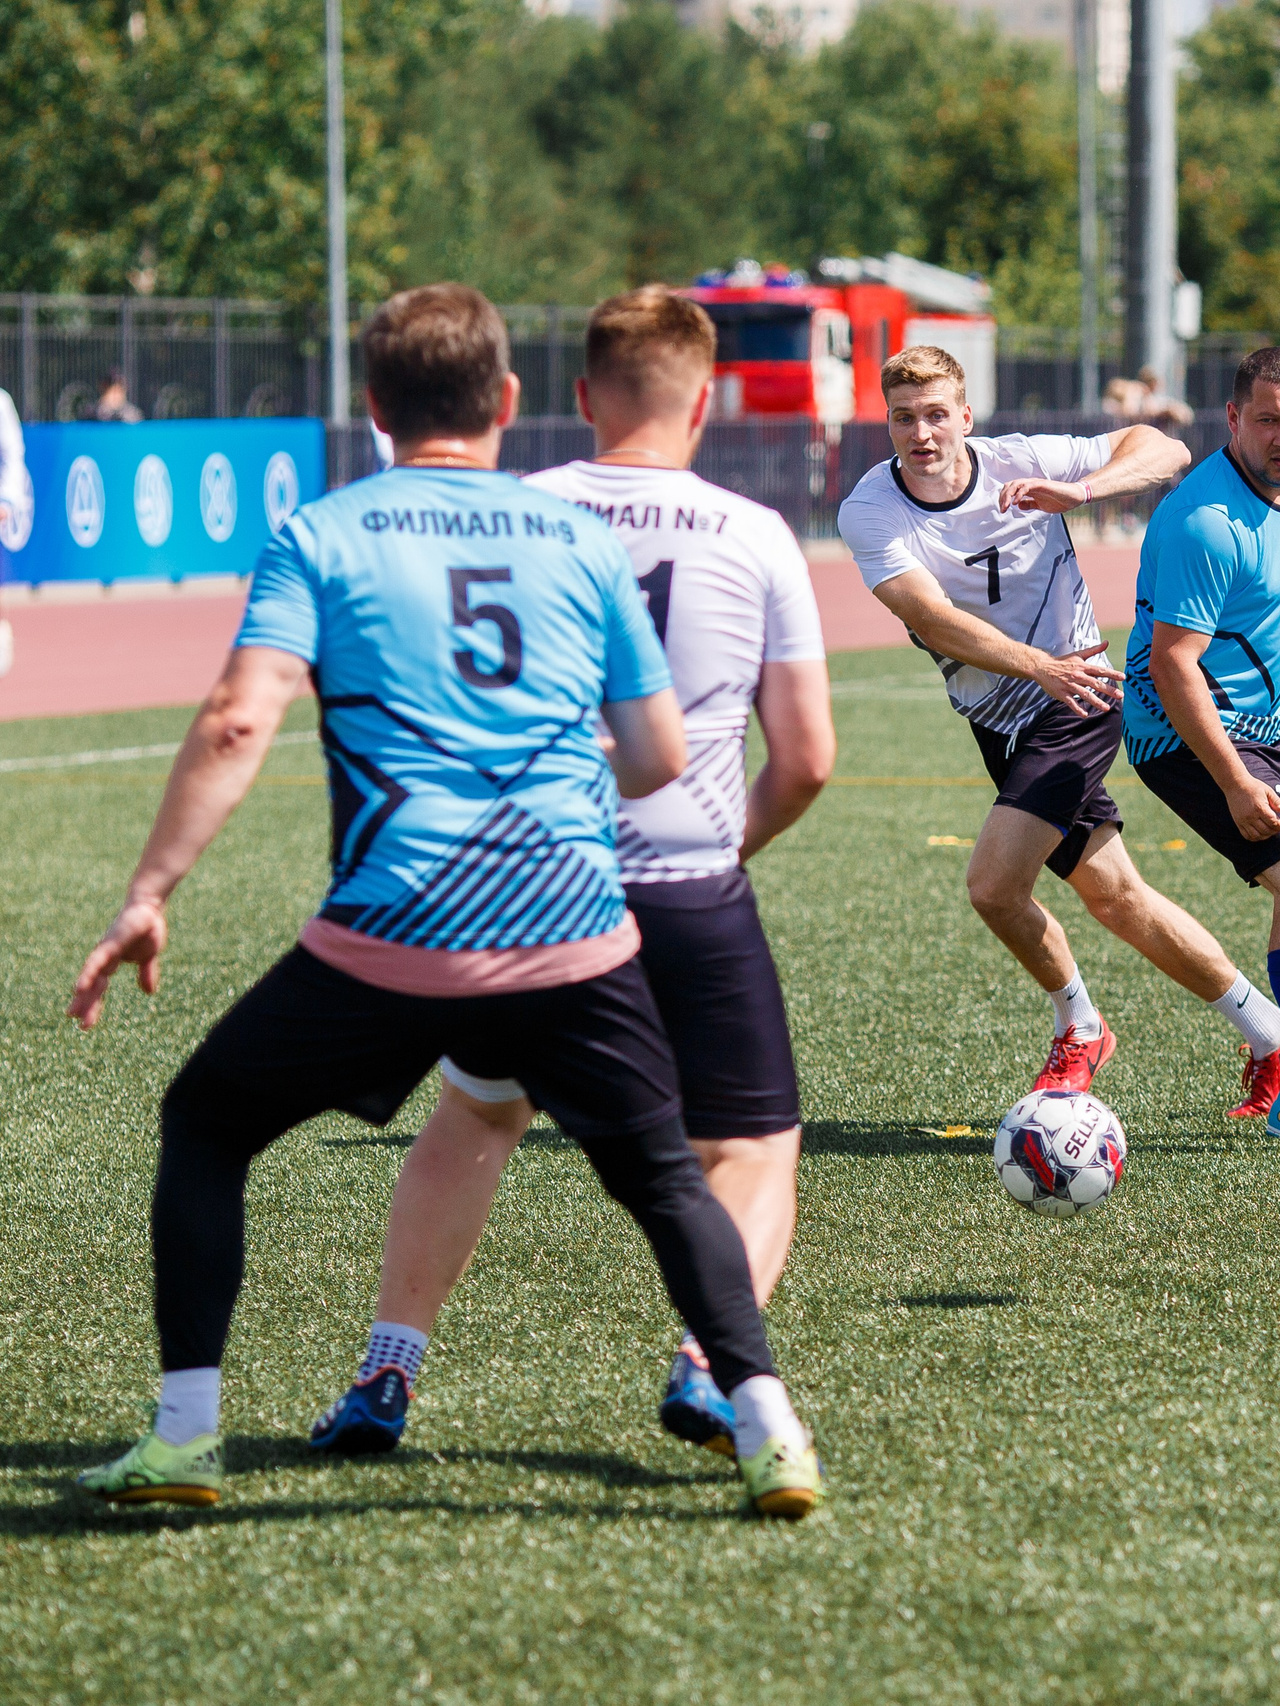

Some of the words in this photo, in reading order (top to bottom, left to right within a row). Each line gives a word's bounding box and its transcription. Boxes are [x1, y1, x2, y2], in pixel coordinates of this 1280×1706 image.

[362, 510, 513, 537] ФИЛИАЛ
[566, 499, 660, 529] ИАЛ
[675, 508, 727, 534] №7
[637, 560, 674, 648] 1
[964, 545, 1001, 605] 7
[447, 567, 522, 688] 5
